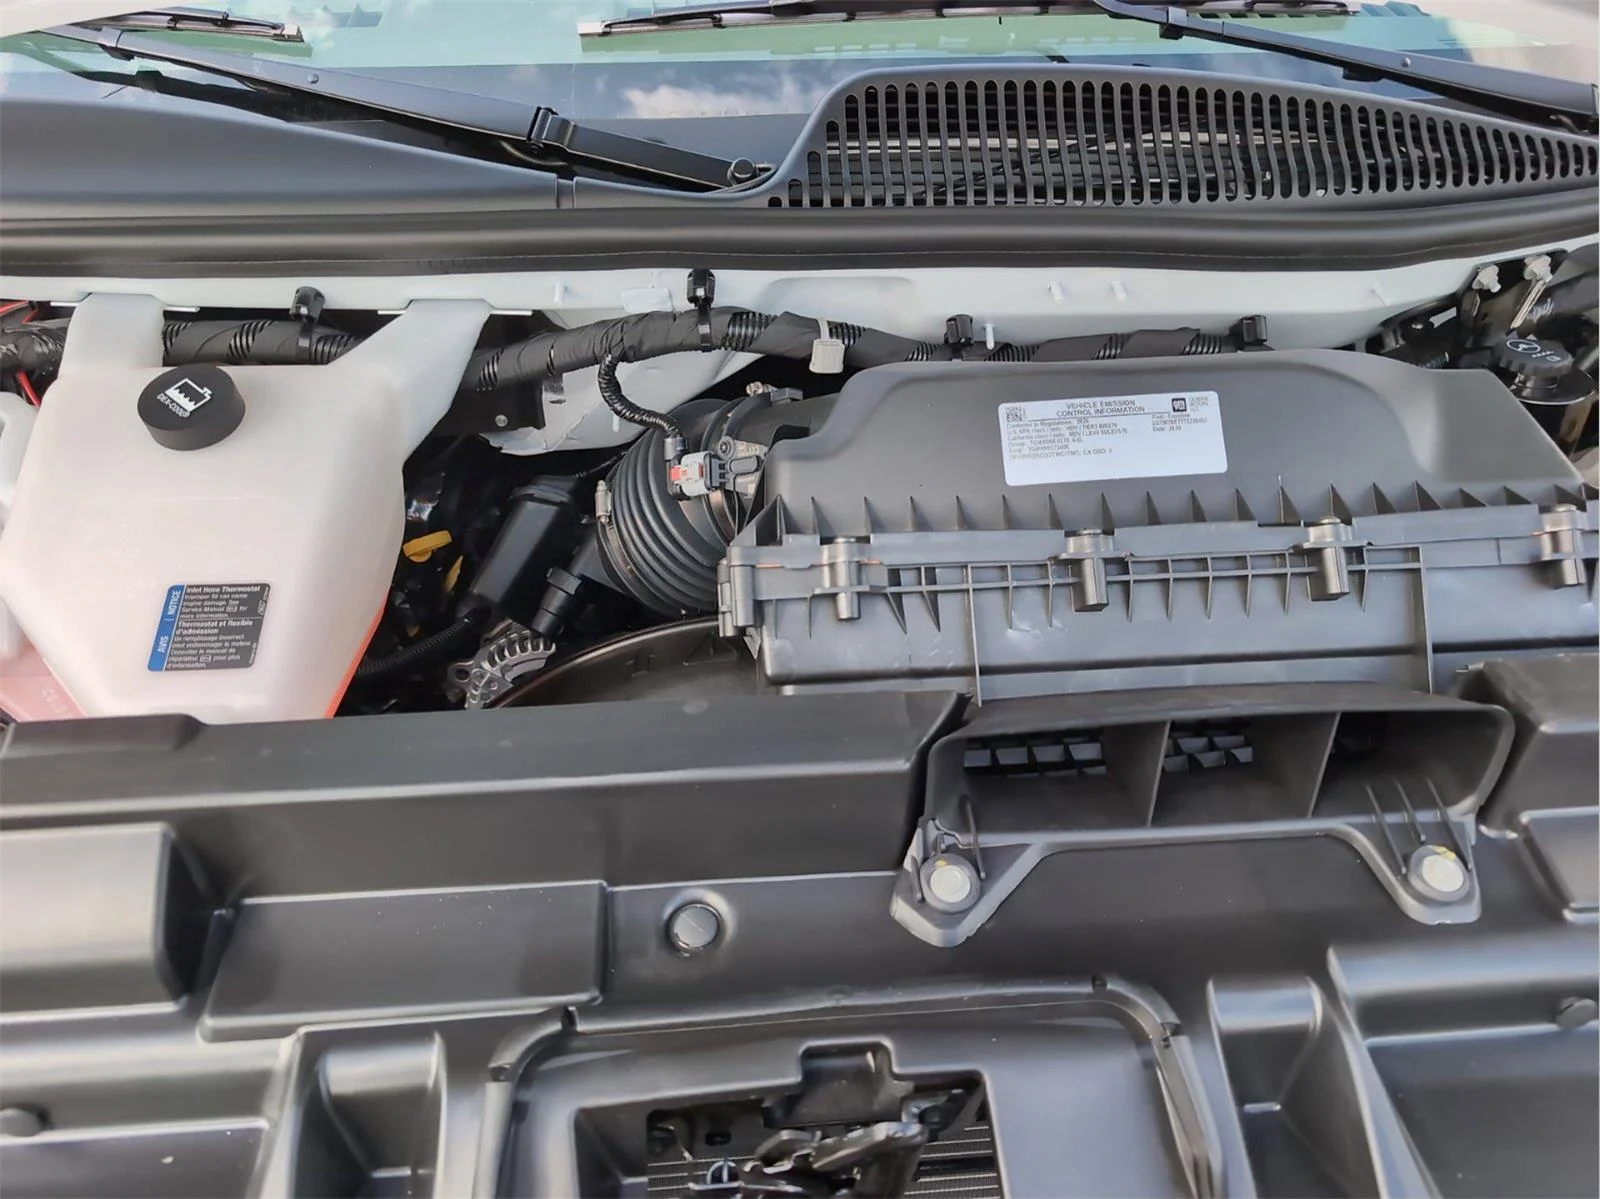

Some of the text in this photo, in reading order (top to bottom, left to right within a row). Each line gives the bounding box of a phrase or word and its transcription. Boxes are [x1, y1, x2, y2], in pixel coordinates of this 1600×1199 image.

[1066, 399, 1136, 410] VEHICLE EMISSION
[1056, 406, 1145, 417] CONTROL INFORMATION
[168, 590, 181, 616] NOTICE
[157, 636, 169, 652] AVIS
